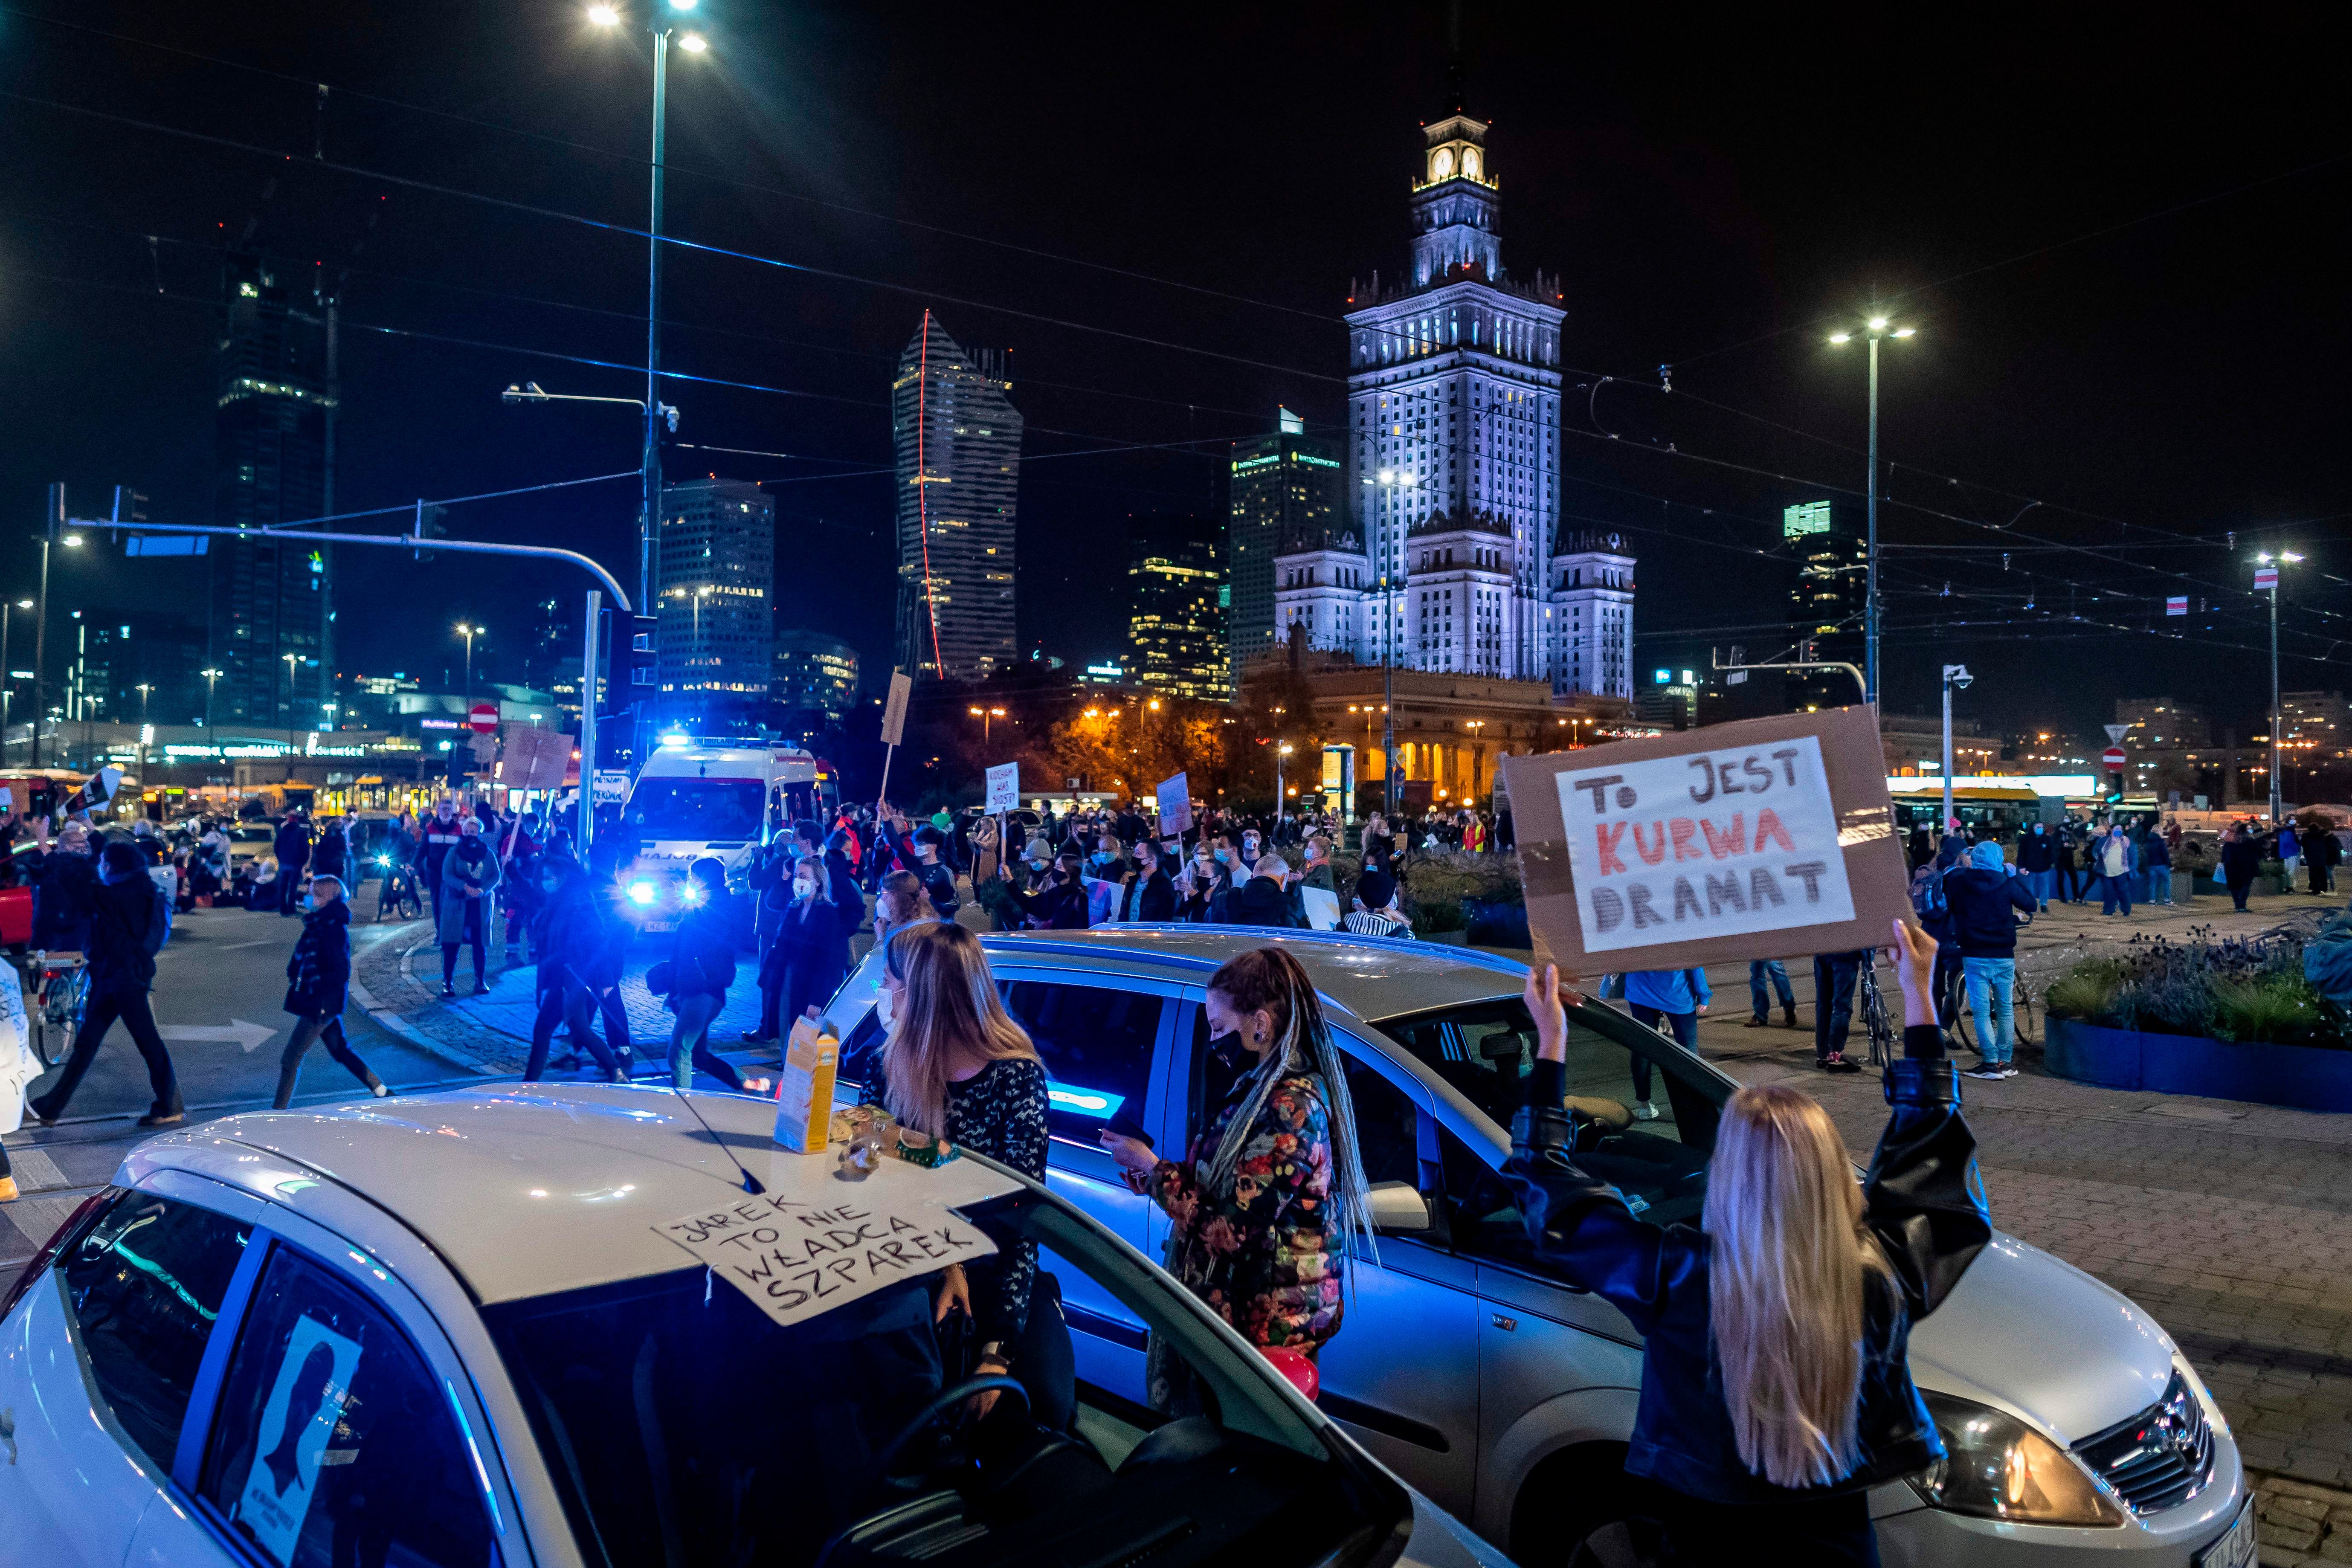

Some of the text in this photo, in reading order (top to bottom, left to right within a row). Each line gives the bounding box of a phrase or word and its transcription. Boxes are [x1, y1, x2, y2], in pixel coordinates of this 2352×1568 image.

[1689, 749, 1798, 803] JEST
[1596, 808, 1795, 876] KURWA
[1591, 860, 1827, 932] DRAMAT
[671, 1194, 807, 1242] JAREK
[719, 1205, 870, 1251] TO NIE
[767, 1227, 973, 1310] SZPAREK
